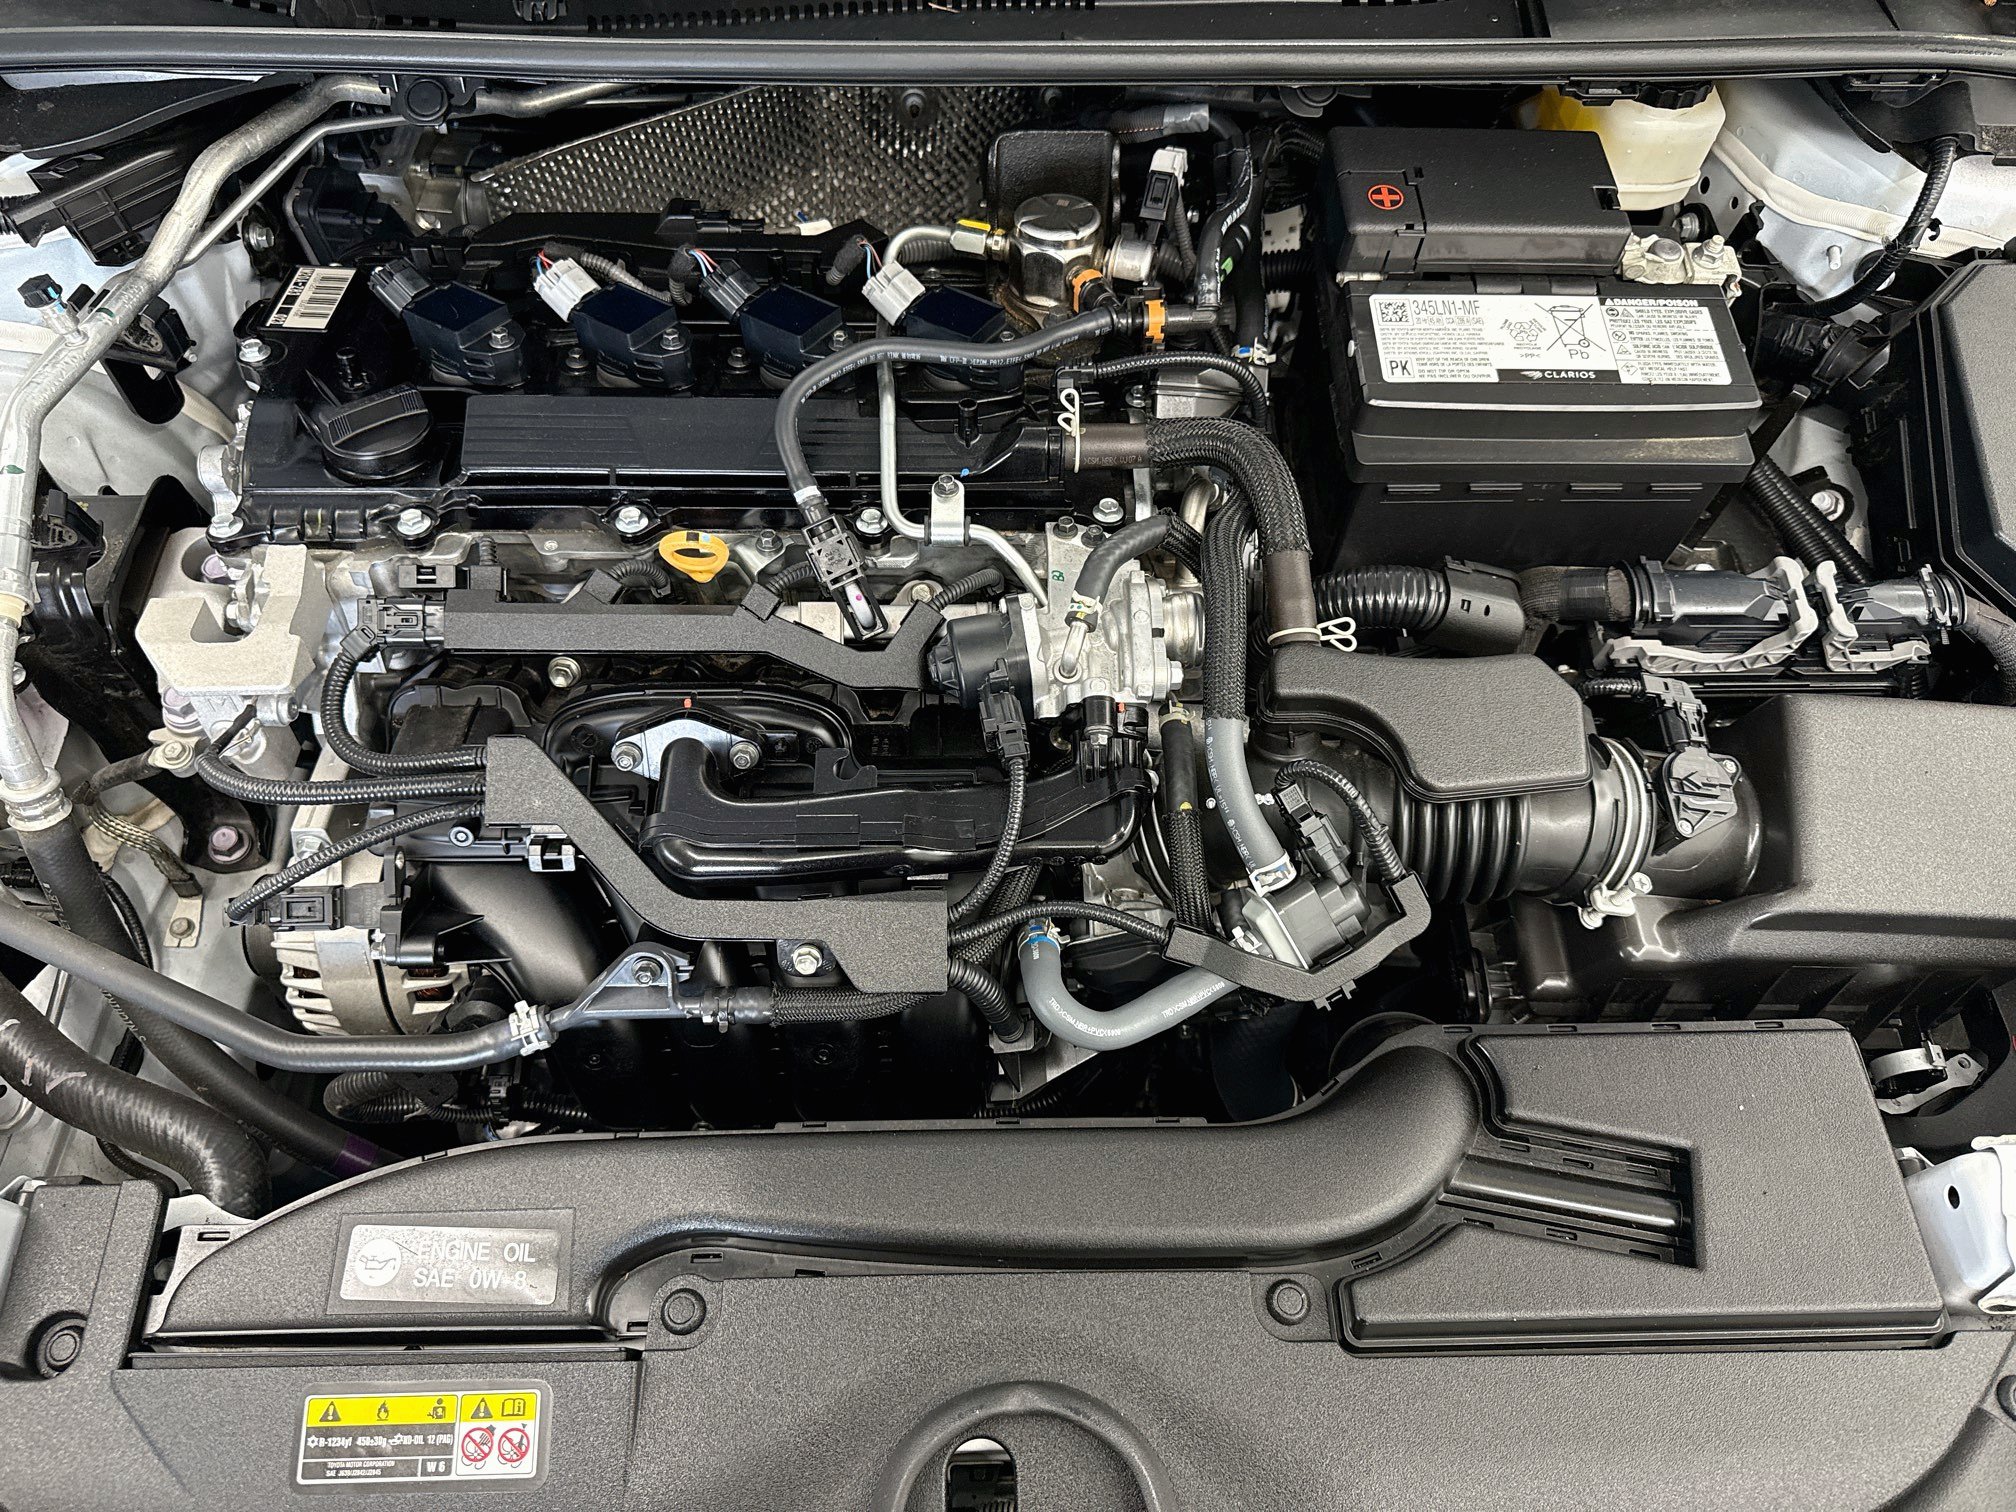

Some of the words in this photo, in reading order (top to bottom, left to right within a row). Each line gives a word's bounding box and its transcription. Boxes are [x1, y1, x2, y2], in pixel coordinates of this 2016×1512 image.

[1412, 299, 1480, 316] 345LN1-MF
[1613, 298, 1699, 307] DANGER/POISON
[1568, 349, 1590, 359] Pb
[1388, 360, 1412, 377] PK
[1544, 371, 1596, 379] CLARIOS
[417, 1241, 492, 1262] ENGINE
[503, 1242, 536, 1263] OIL
[412, 1268, 456, 1288] SAE
[318, 1436, 353, 1448] R-1234yf
[427, 1434, 436, 1445] 12
[436, 1433, 454, 1446] (PAG)
[362, 1460, 396, 1468] CORPORATION
[426, 1461, 437, 1472] W
[438, 1461, 446, 1472] 6
